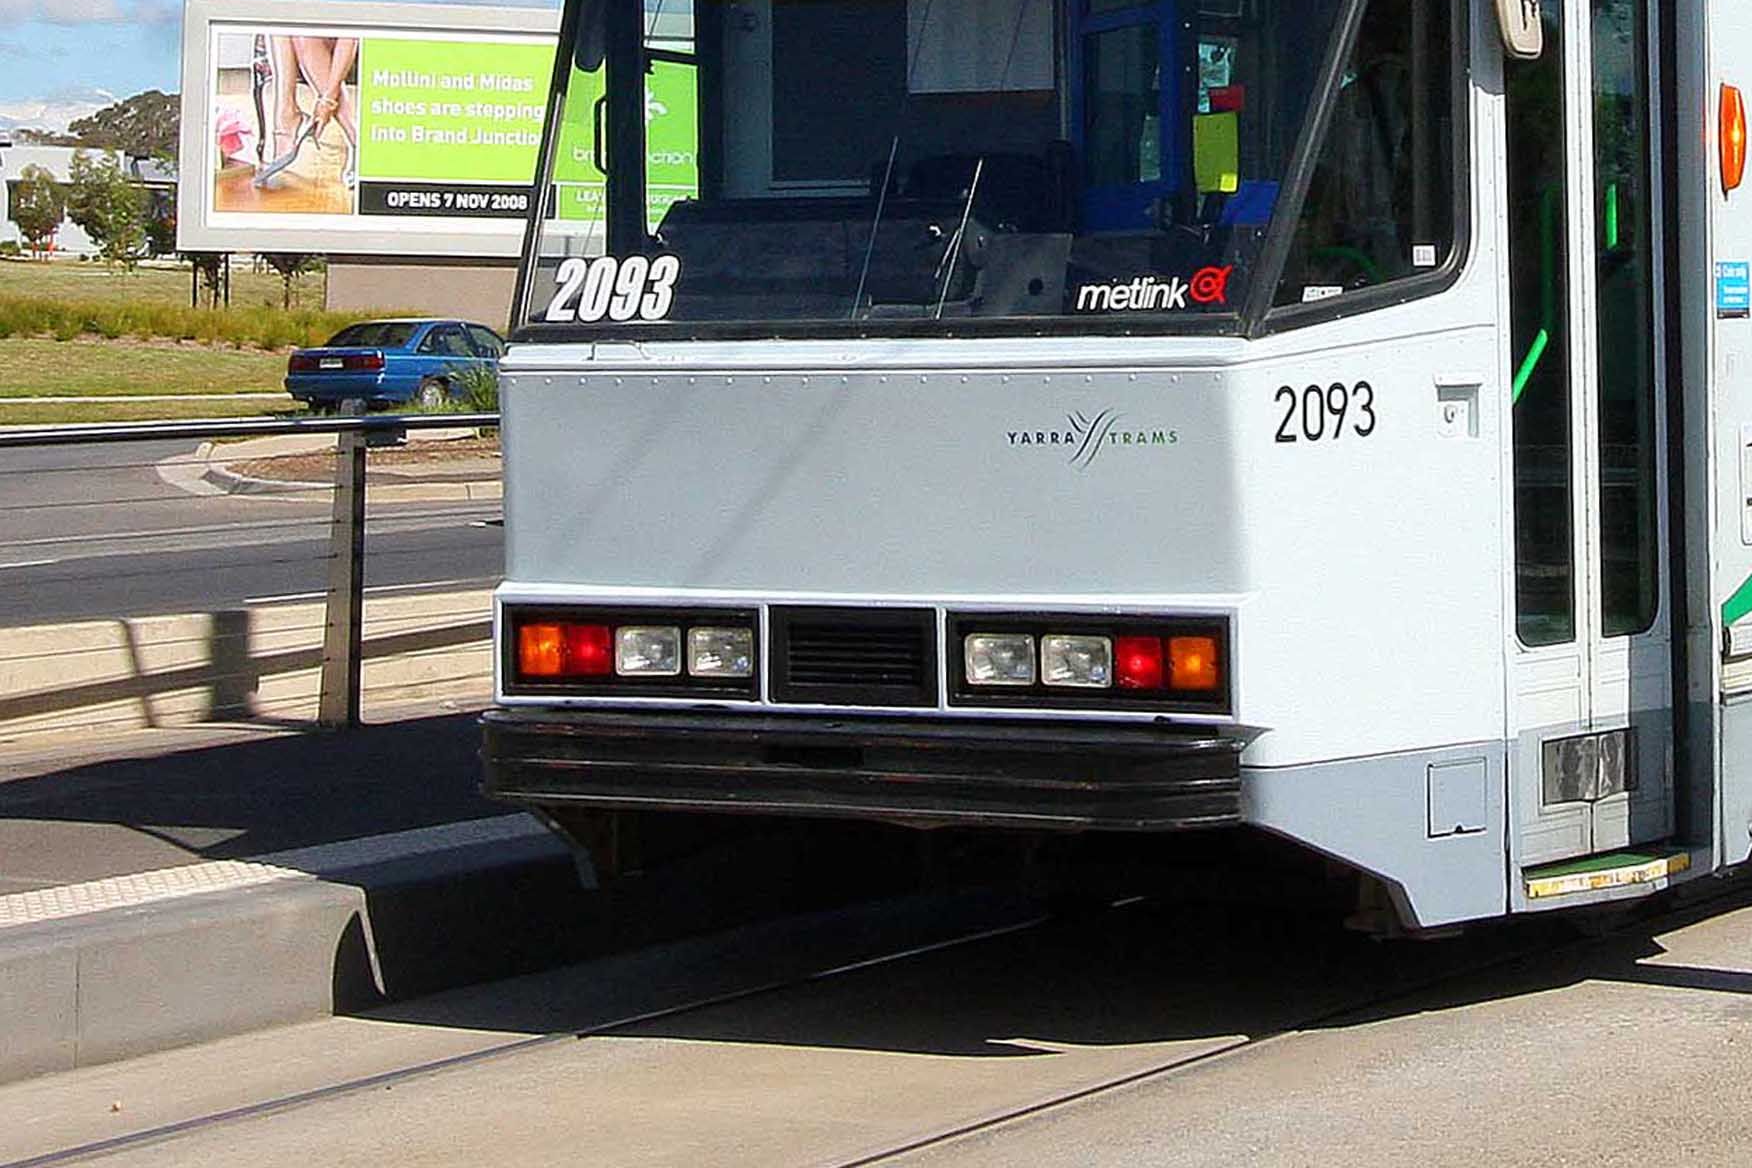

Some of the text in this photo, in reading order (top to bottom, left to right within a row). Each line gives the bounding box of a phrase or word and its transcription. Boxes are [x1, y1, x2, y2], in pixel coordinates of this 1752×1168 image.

[371, 70, 533, 91] Mollini and Midas
[371, 97, 545, 121] shoes are stepping
[411, 125, 467, 145] Brand
[468, 128, 541, 146] Junctio
[387, 191, 528, 210] OPENS 7 NOV 2008
[545, 255, 680, 322] 2093
[1076, 275, 1189, 310] metlink
[1274, 380, 1376, 443] 2093
[1007, 429, 1179, 445] YARRA TRAMS
